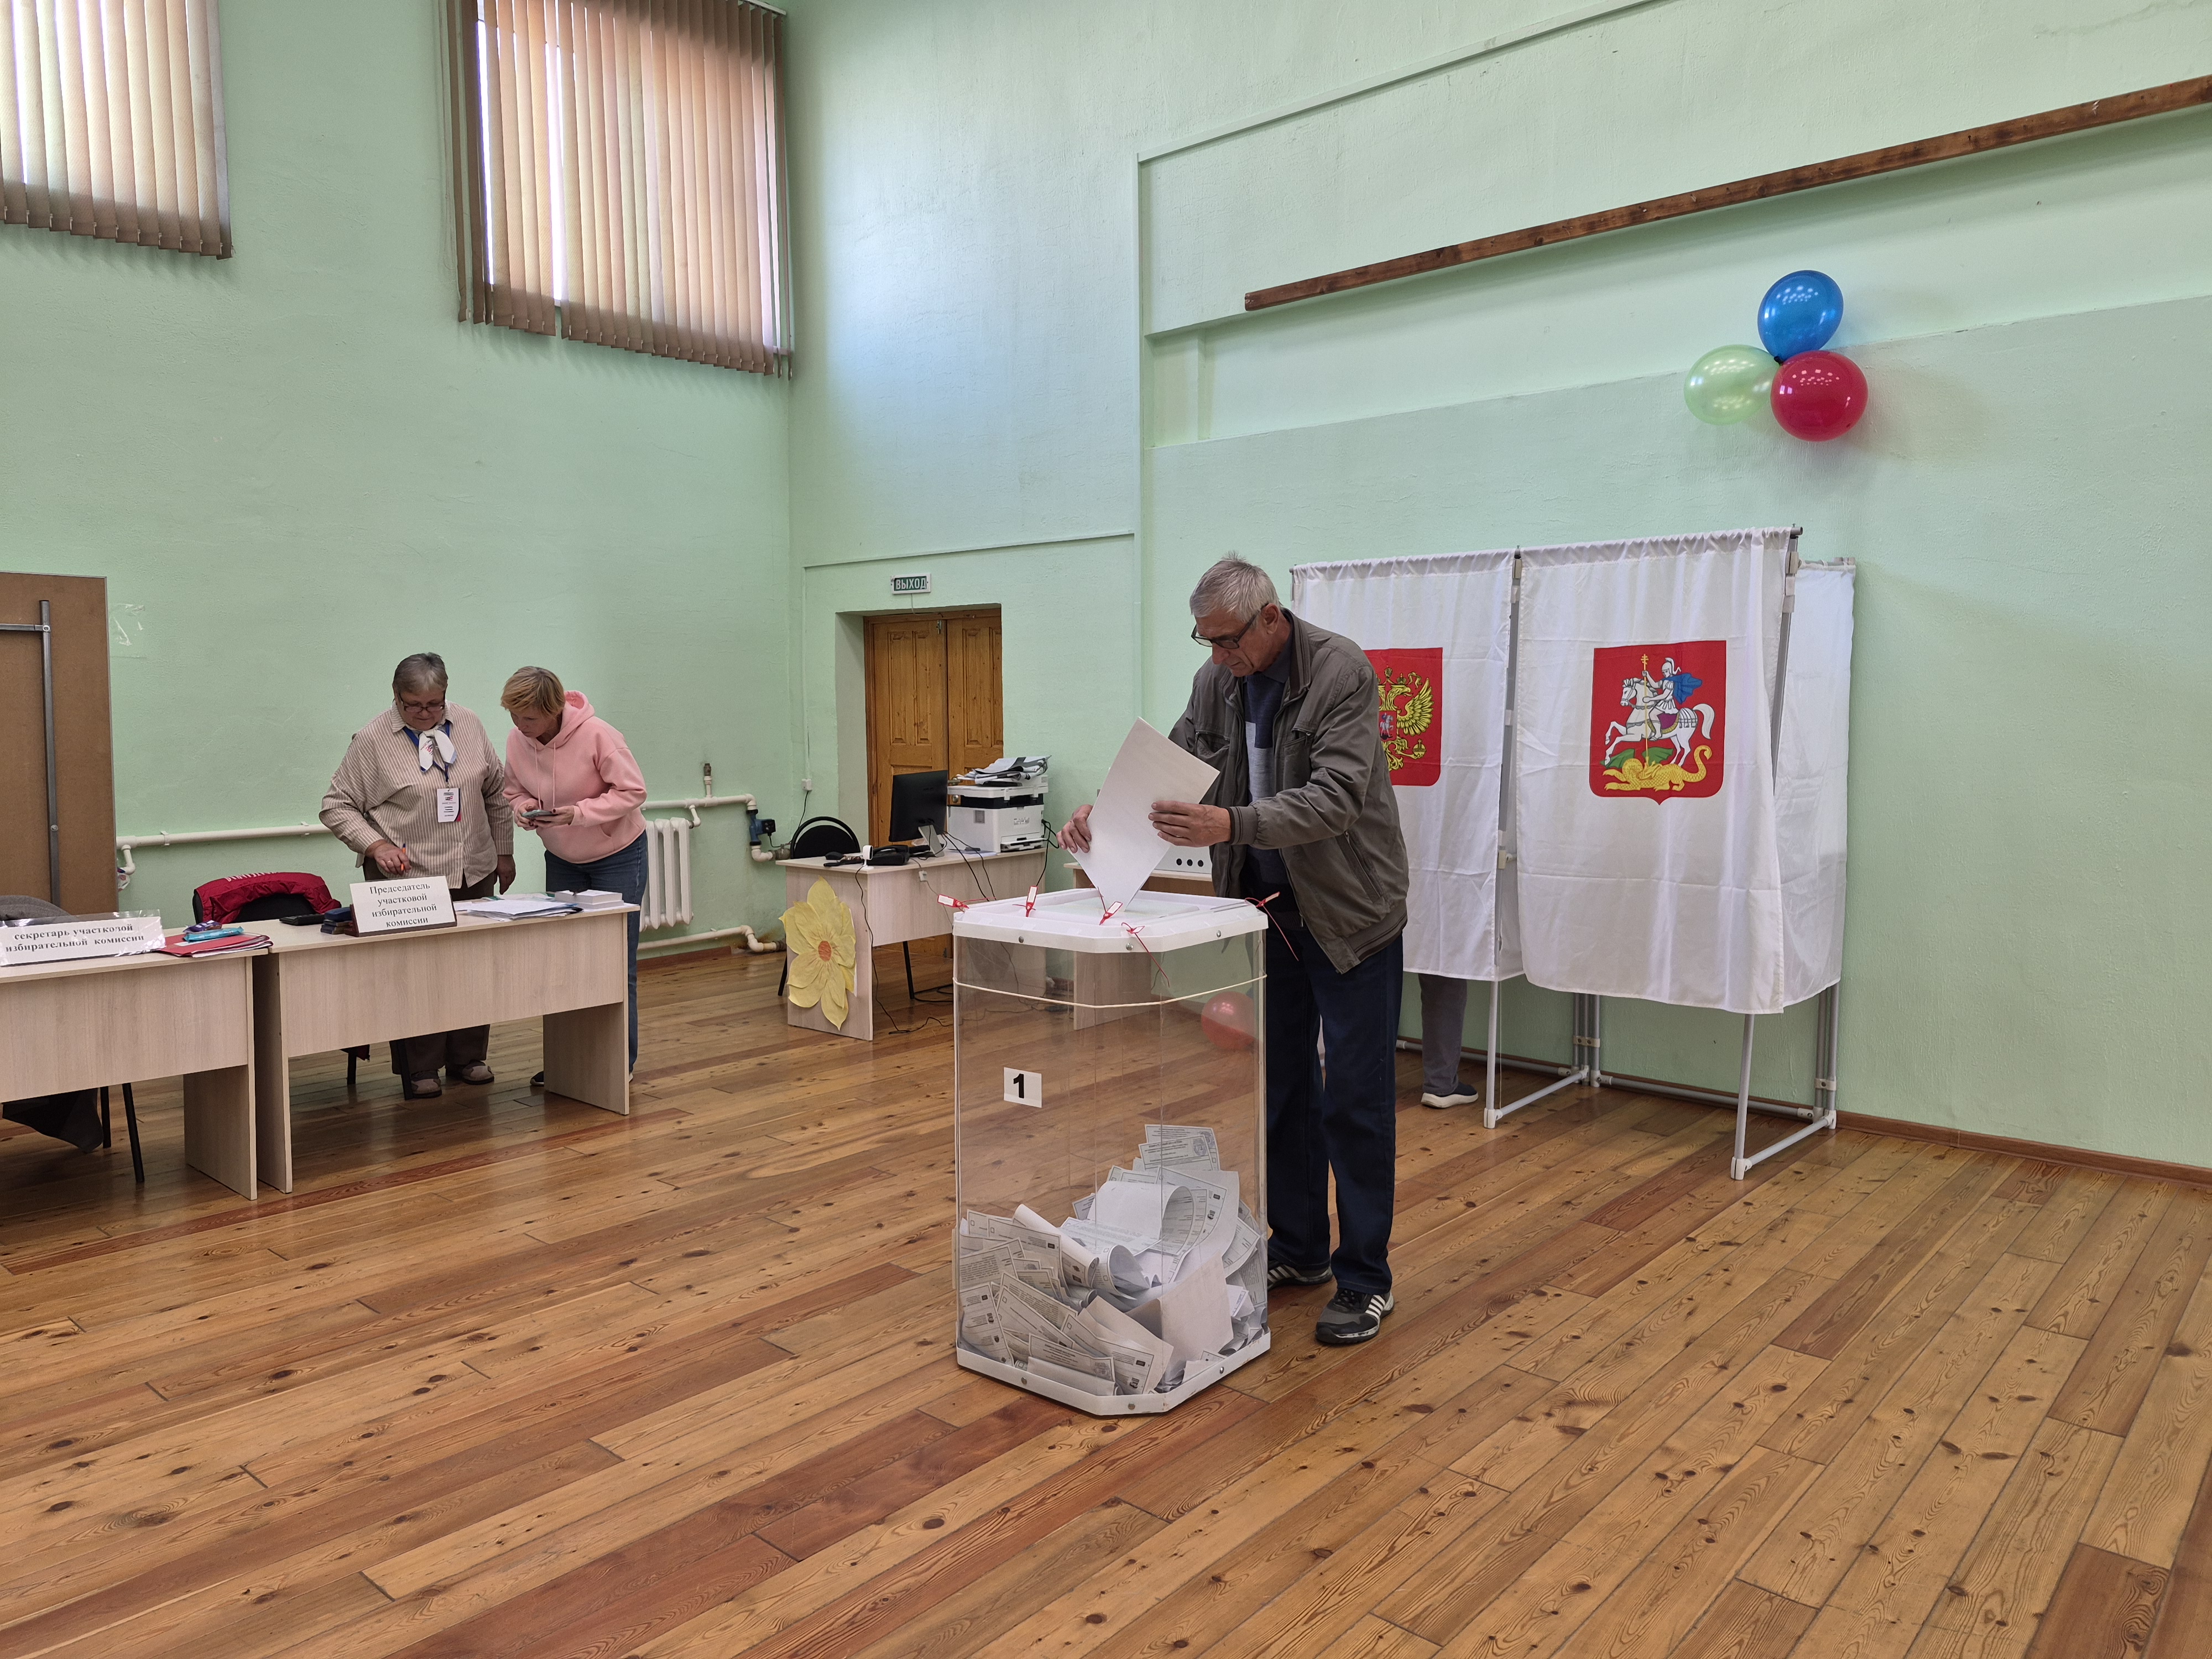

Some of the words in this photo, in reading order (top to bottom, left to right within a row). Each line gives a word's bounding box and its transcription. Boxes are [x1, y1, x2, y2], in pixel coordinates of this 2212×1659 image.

[896, 578, 926, 589] ВЫХОД
[370, 883, 430, 895] Председатель
[378, 893, 427, 906] участковой
[372, 904, 437, 917] избирательной
[386, 917, 428, 927] комиссии
[14, 929, 70, 940] секретарь
[73, 924, 133, 936] участковой
[6, 938, 87, 951] избирательной
[94, 935, 144, 945] комиссии
[1013, 1073, 1024, 1099] 1
